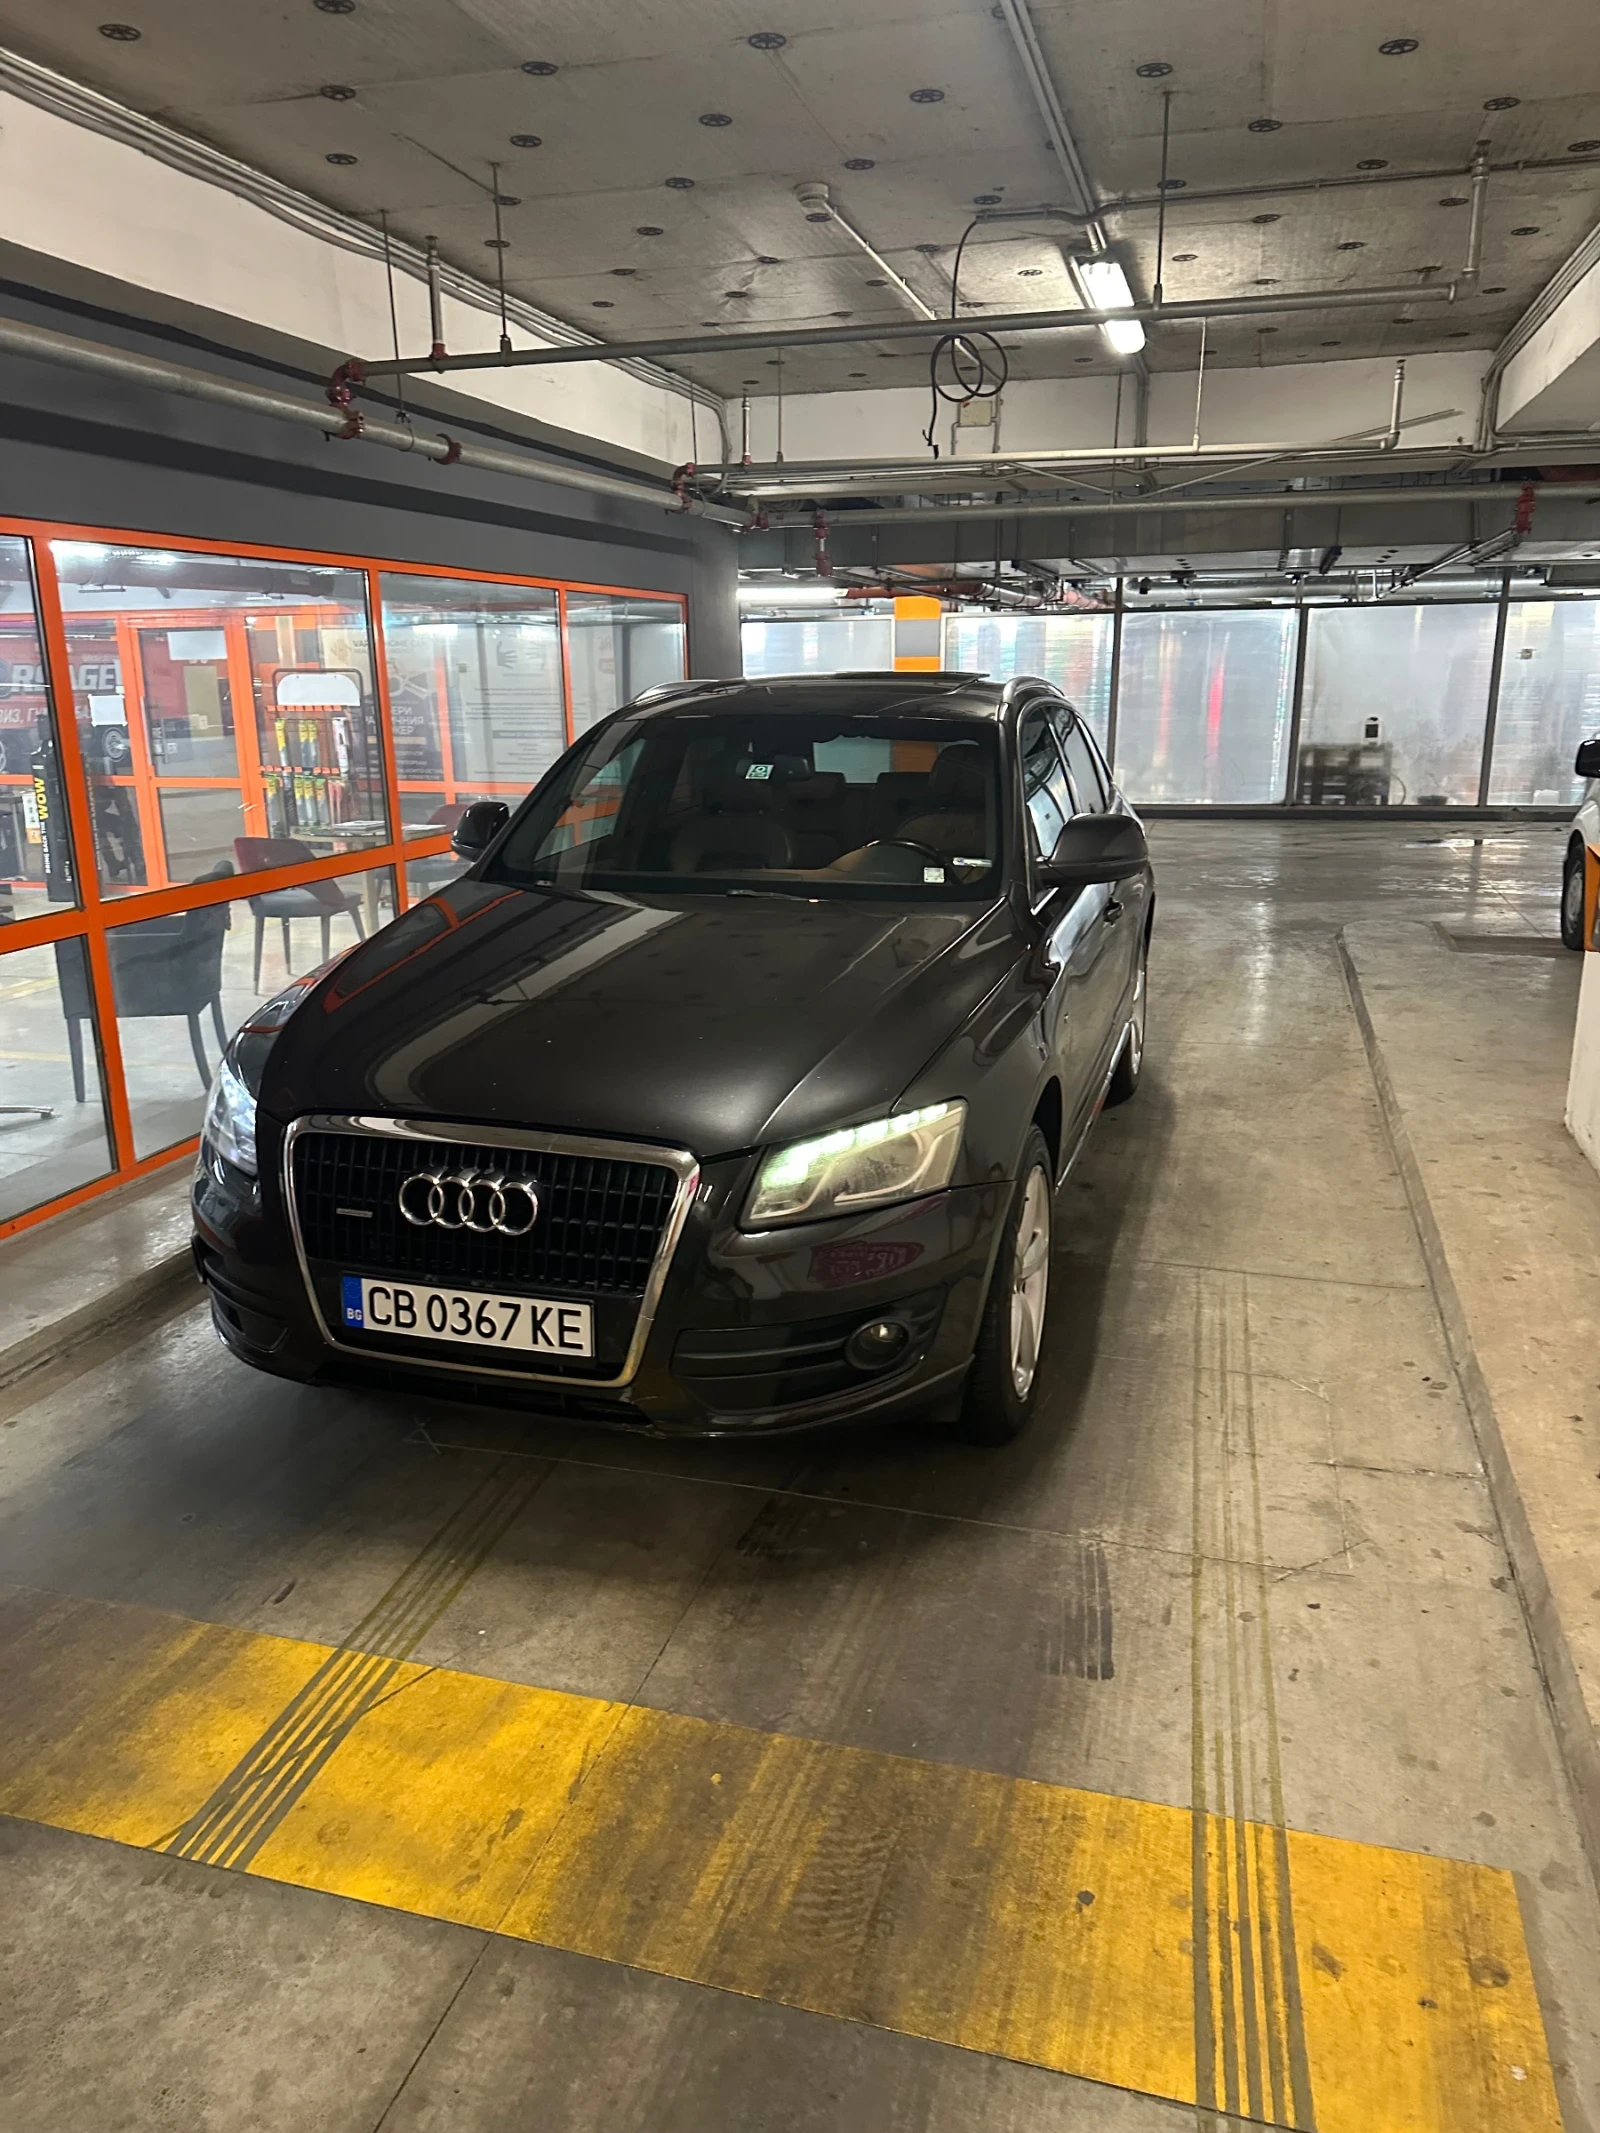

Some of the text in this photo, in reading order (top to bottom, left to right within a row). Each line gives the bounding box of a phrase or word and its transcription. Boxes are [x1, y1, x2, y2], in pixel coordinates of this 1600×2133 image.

[34, 777, 49, 821] WOW
[346, 1307, 363, 1321] BG
[368, 1286, 584, 1350] CB 0367 KE
